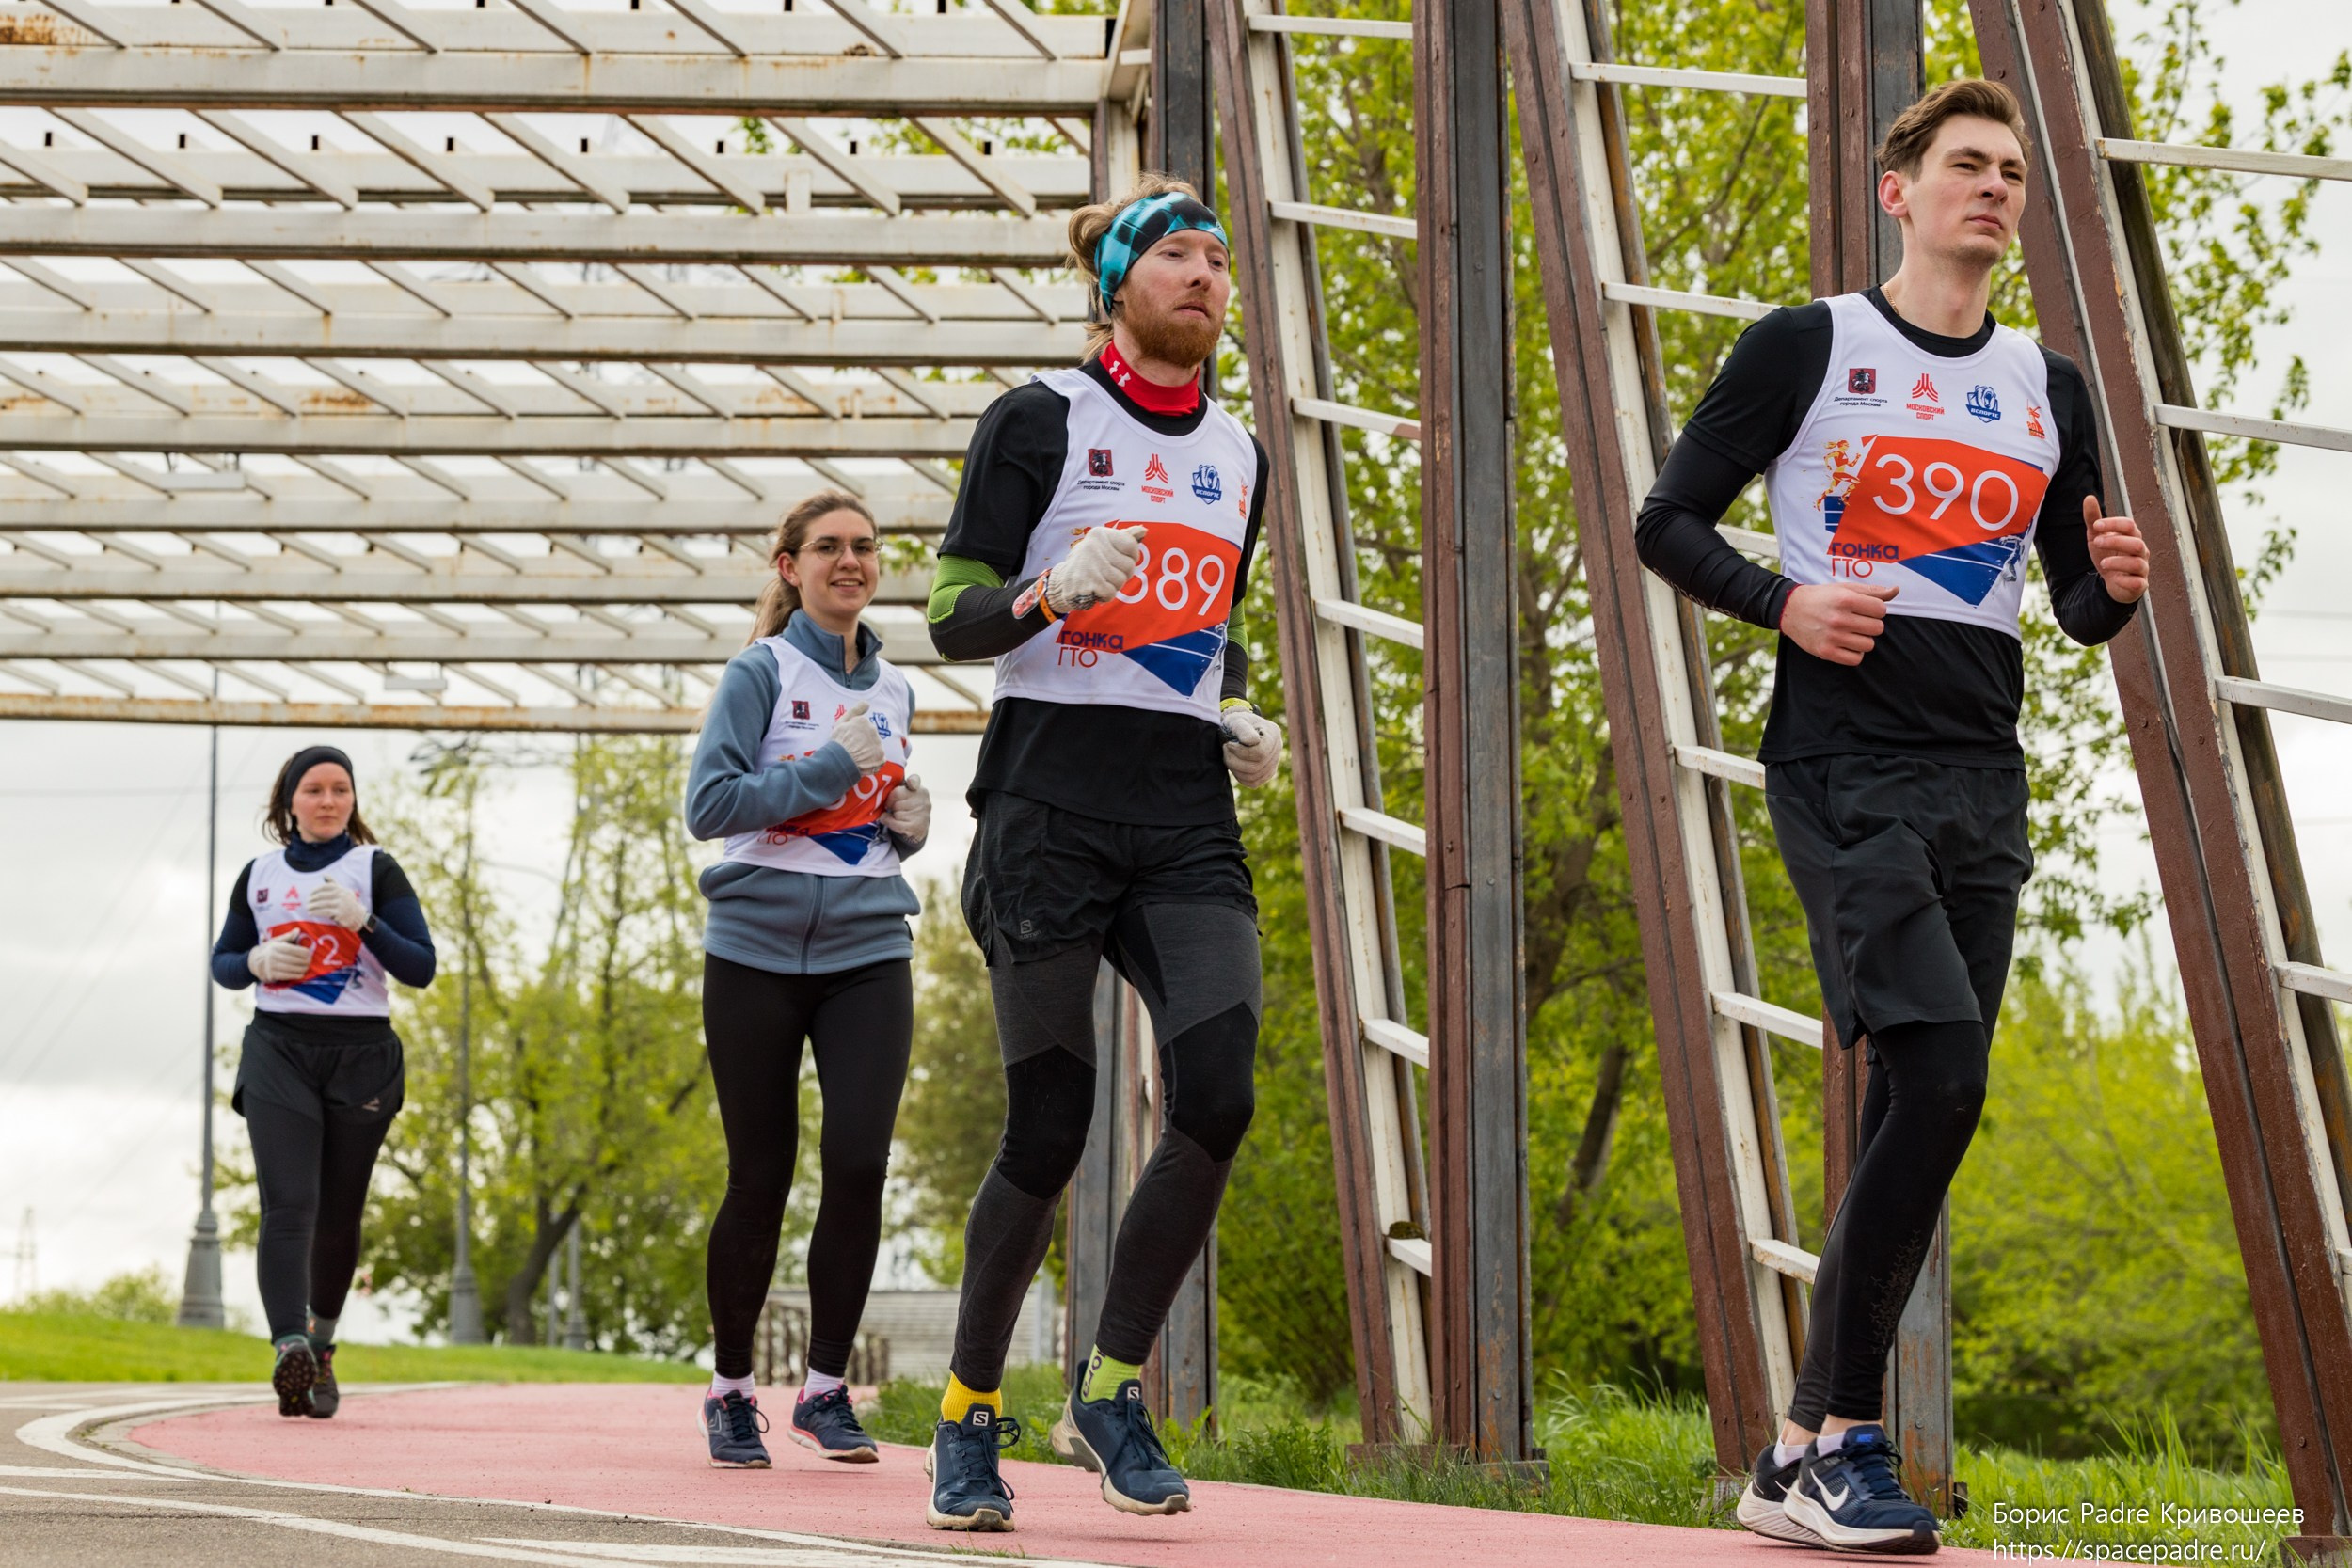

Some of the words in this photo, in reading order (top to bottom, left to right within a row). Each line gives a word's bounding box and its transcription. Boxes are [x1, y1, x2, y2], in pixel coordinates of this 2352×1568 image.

[1906, 403, 1945, 415] МОСКОВСКИЙ
[1915, 412, 1935, 420] СПОРТ
[1970, 407, 1999, 419] ВСПОРТЕ
[1872, 453, 2019, 531] 390
[1832, 558, 1873, 578] ГТО
[1115, 542, 1225, 616] 389
[1057, 646, 1098, 668] ГТО
